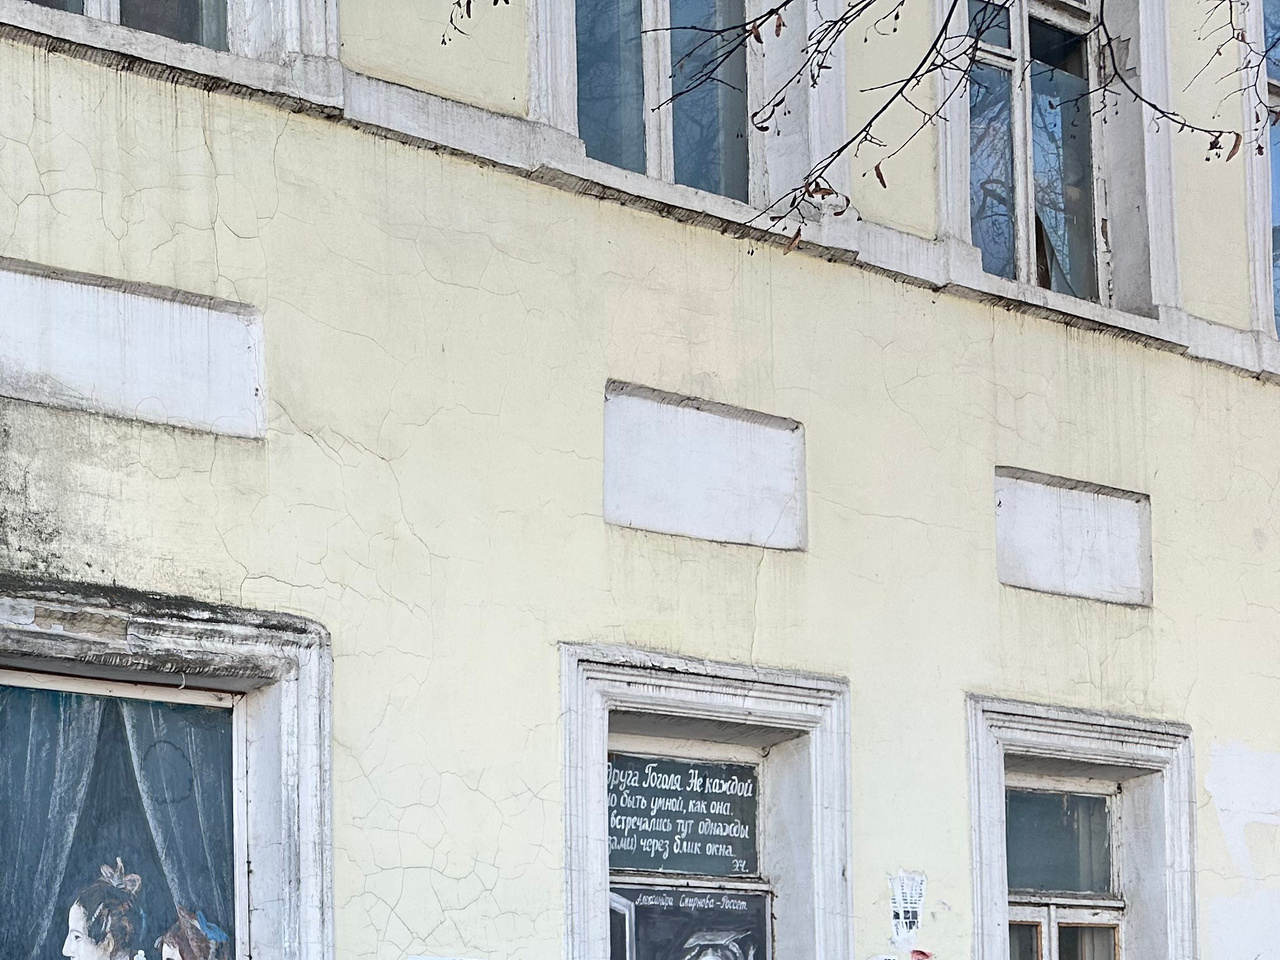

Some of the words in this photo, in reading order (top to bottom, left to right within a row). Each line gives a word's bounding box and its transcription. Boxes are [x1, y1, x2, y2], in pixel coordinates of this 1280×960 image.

[686, 769, 703, 792] Не
[705, 776, 754, 798] каждой
[620, 790, 647, 809] быть
[650, 796, 687, 815] умной,
[688, 800, 707, 813] как
[710, 802, 734, 816] она.
[610, 809, 672, 836] встречались
[676, 819, 694, 839] тут
[698, 819, 749, 839] однажды
[640, 838, 669, 859] через
[673, 835, 701, 855] блик
